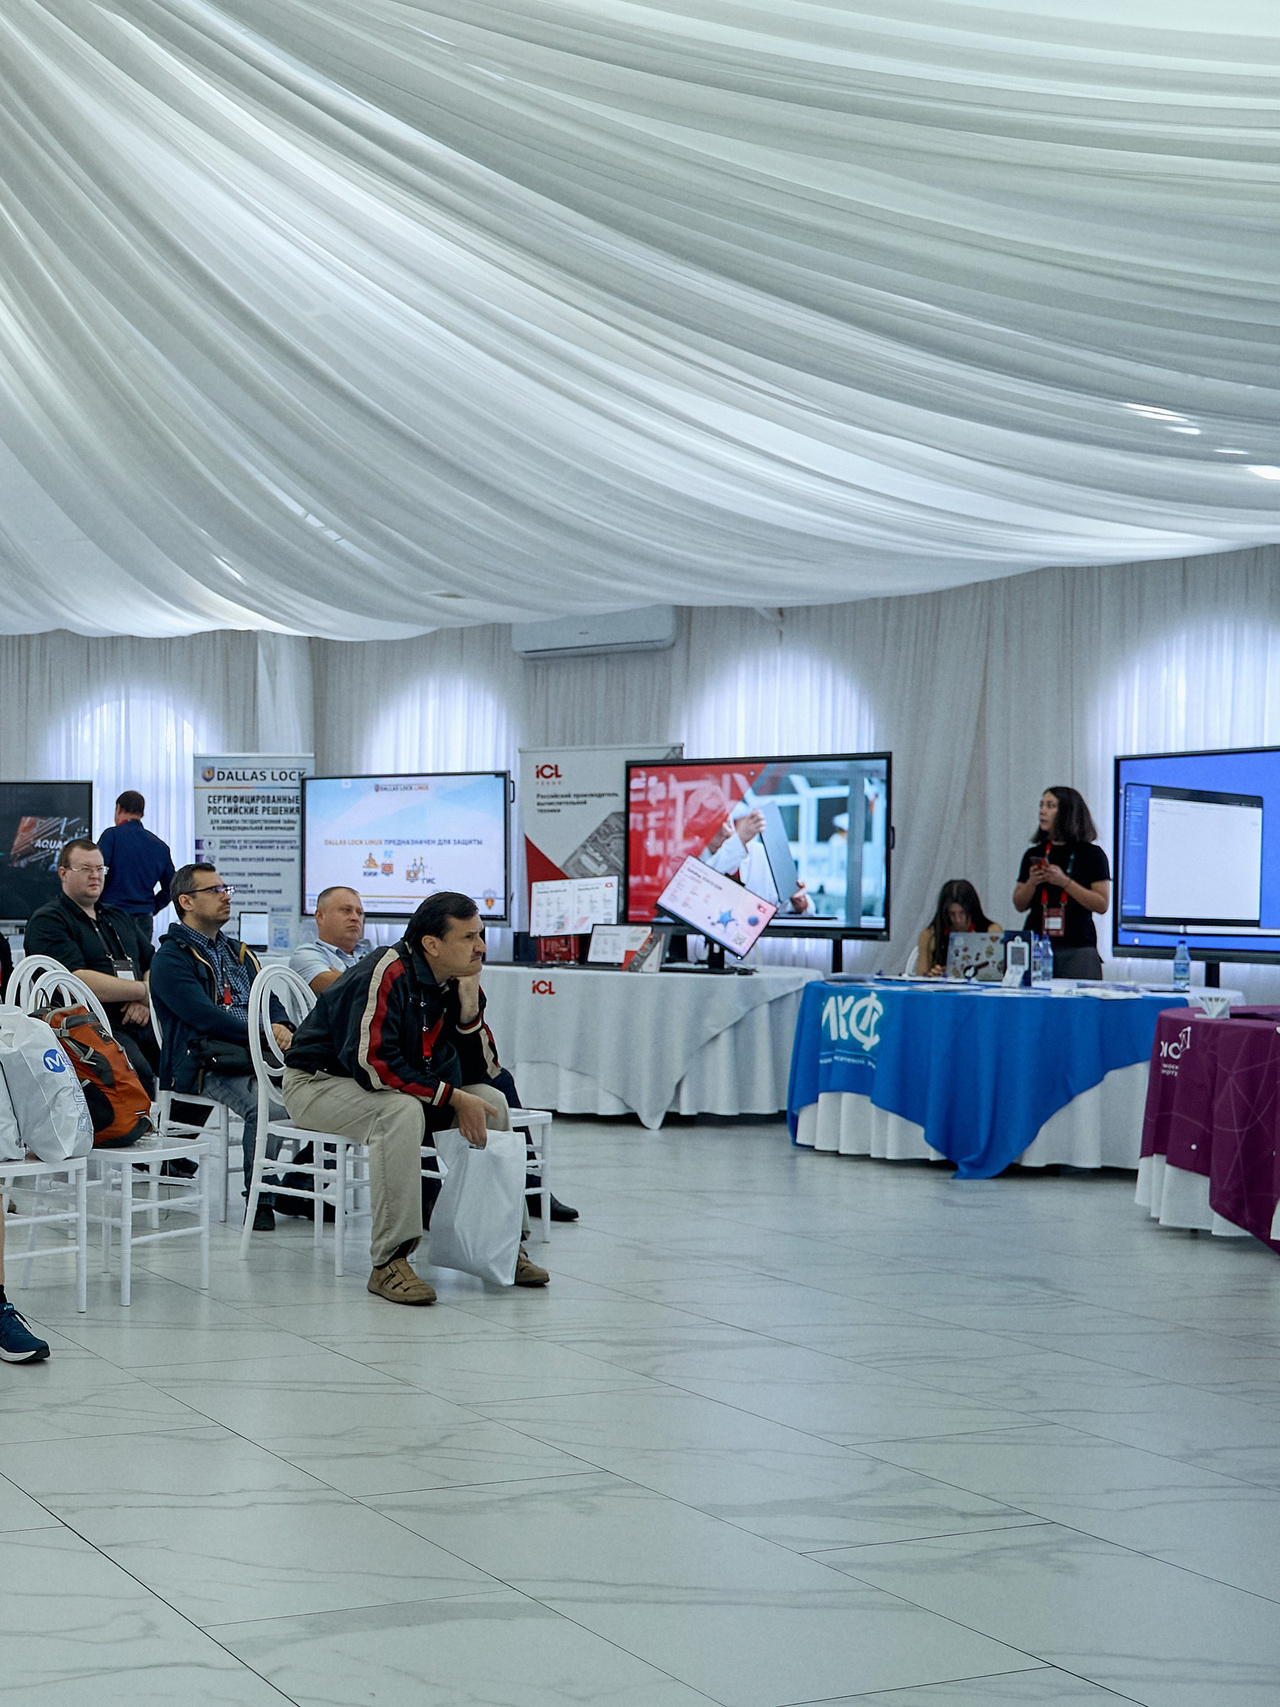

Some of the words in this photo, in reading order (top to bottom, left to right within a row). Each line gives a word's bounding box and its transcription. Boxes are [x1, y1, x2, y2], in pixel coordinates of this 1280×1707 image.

[217, 771, 267, 781] DALLAS
[271, 771, 307, 781] LOCK
[207, 795, 300, 805] СЕРТИФИЦИРОВАННЫЕ
[207, 805, 259, 815] РОССИЙСКИЕ
[262, 806, 300, 815] РЕШЕНИЯ
